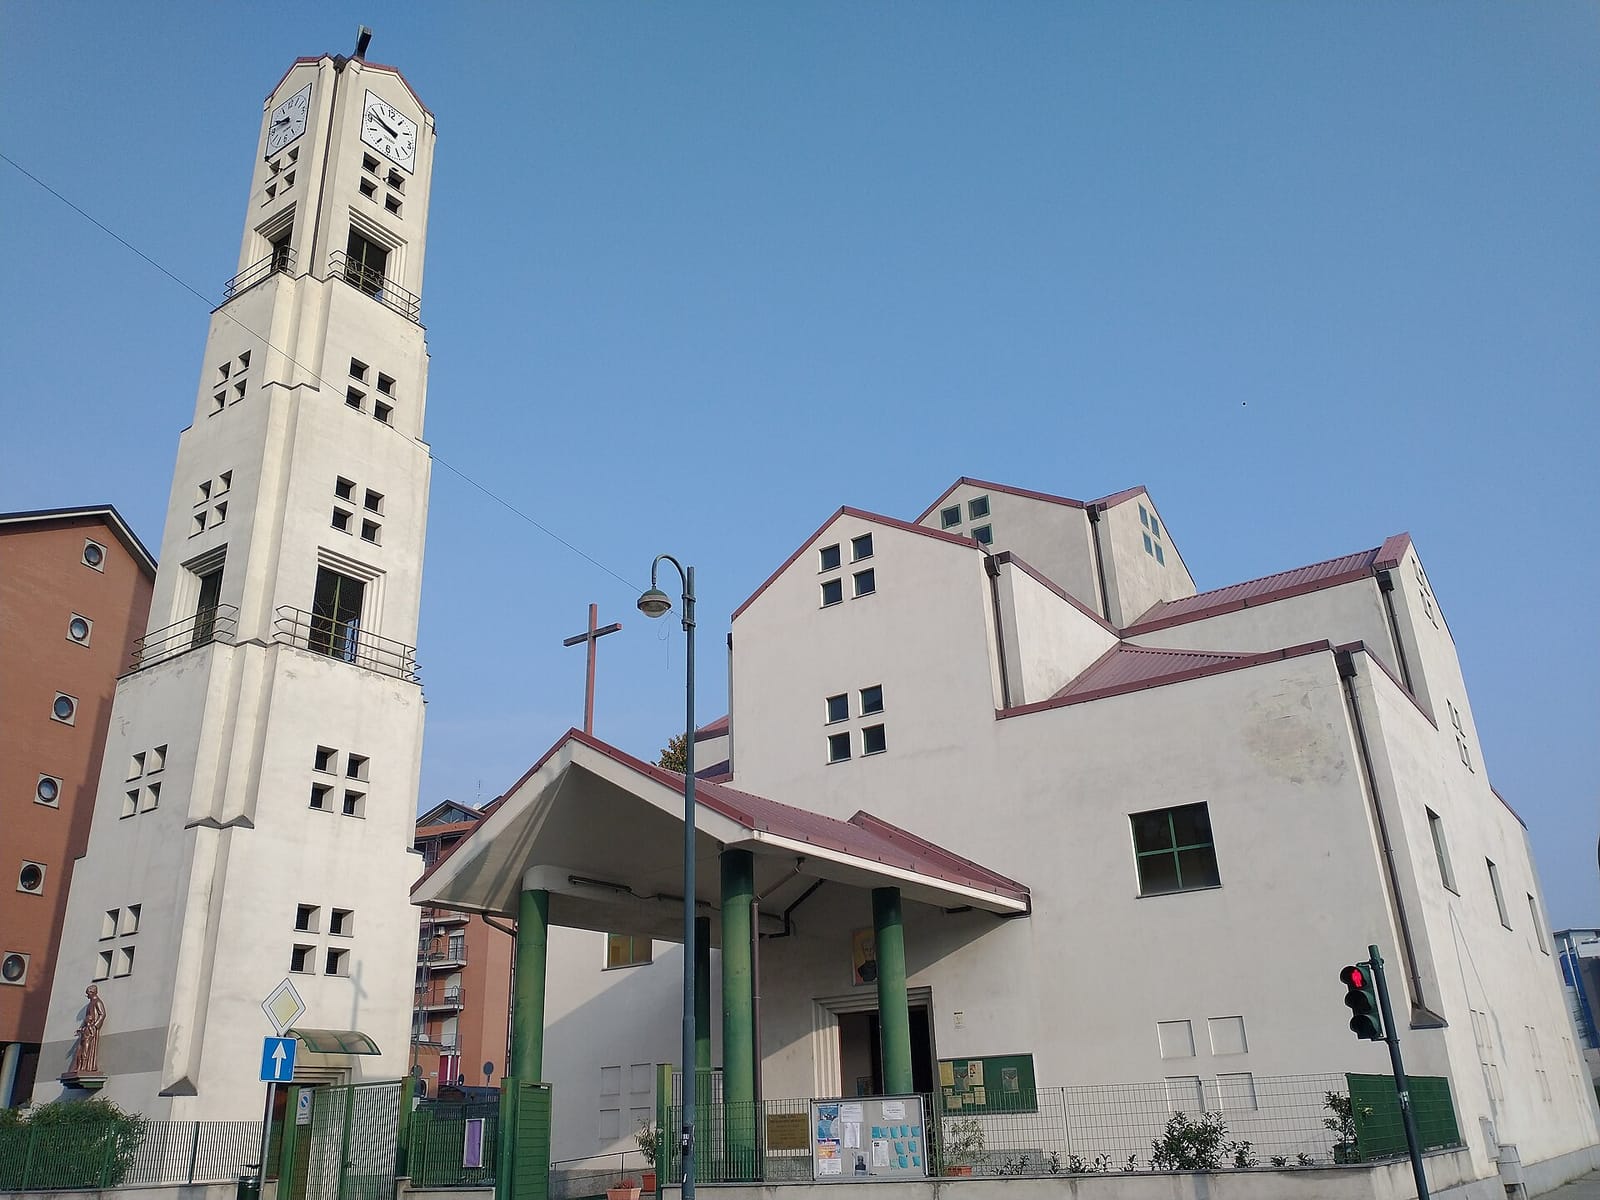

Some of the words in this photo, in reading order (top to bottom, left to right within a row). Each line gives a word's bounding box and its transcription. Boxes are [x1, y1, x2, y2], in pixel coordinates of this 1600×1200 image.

[368, 112, 373, 122] 9
[388, 109, 396, 121] 12
[385, 144, 390, 153] 6
[406, 140, 412, 150] 3
